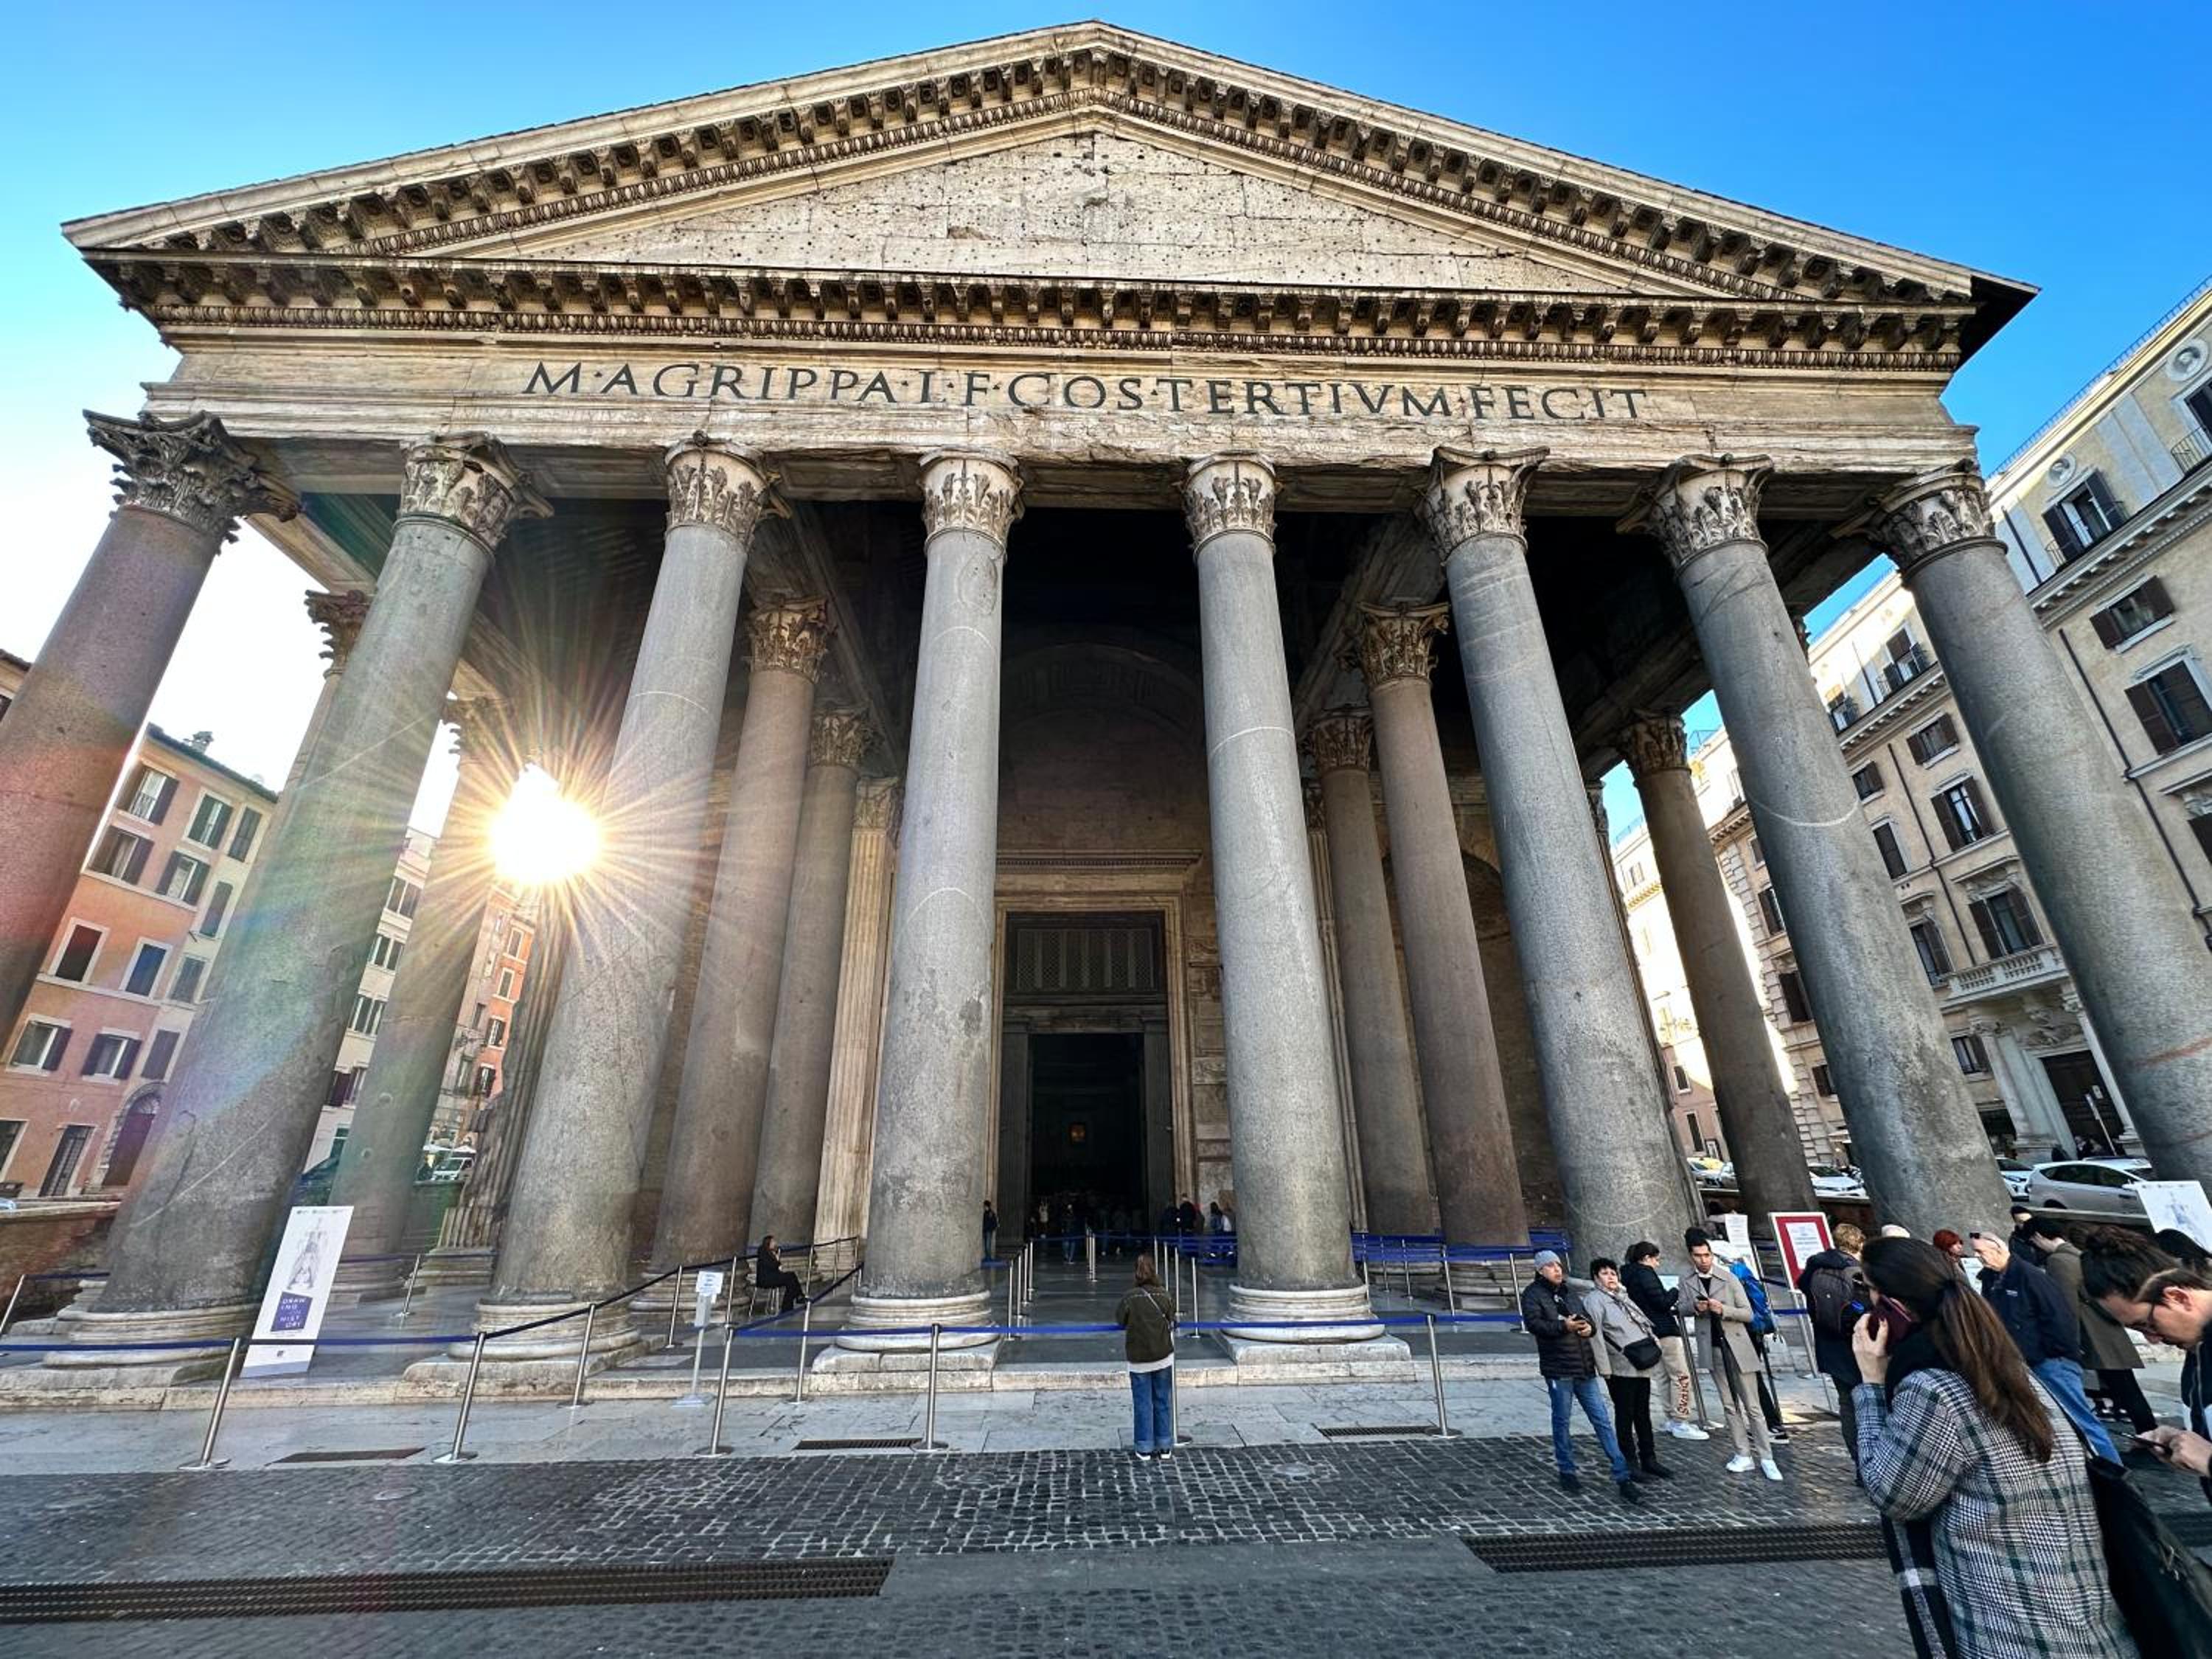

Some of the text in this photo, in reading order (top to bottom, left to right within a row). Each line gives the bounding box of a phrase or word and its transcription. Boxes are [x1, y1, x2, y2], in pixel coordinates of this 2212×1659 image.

[521, 361, 582, 394] M
[599, 363, 897, 403] AGRIPPA
[964, 372, 990, 406] F
[1007, 372, 1143, 411] COS
[1155, 376, 1453, 418] TERTIVM
[1467, 384, 1647, 420] FECIT
